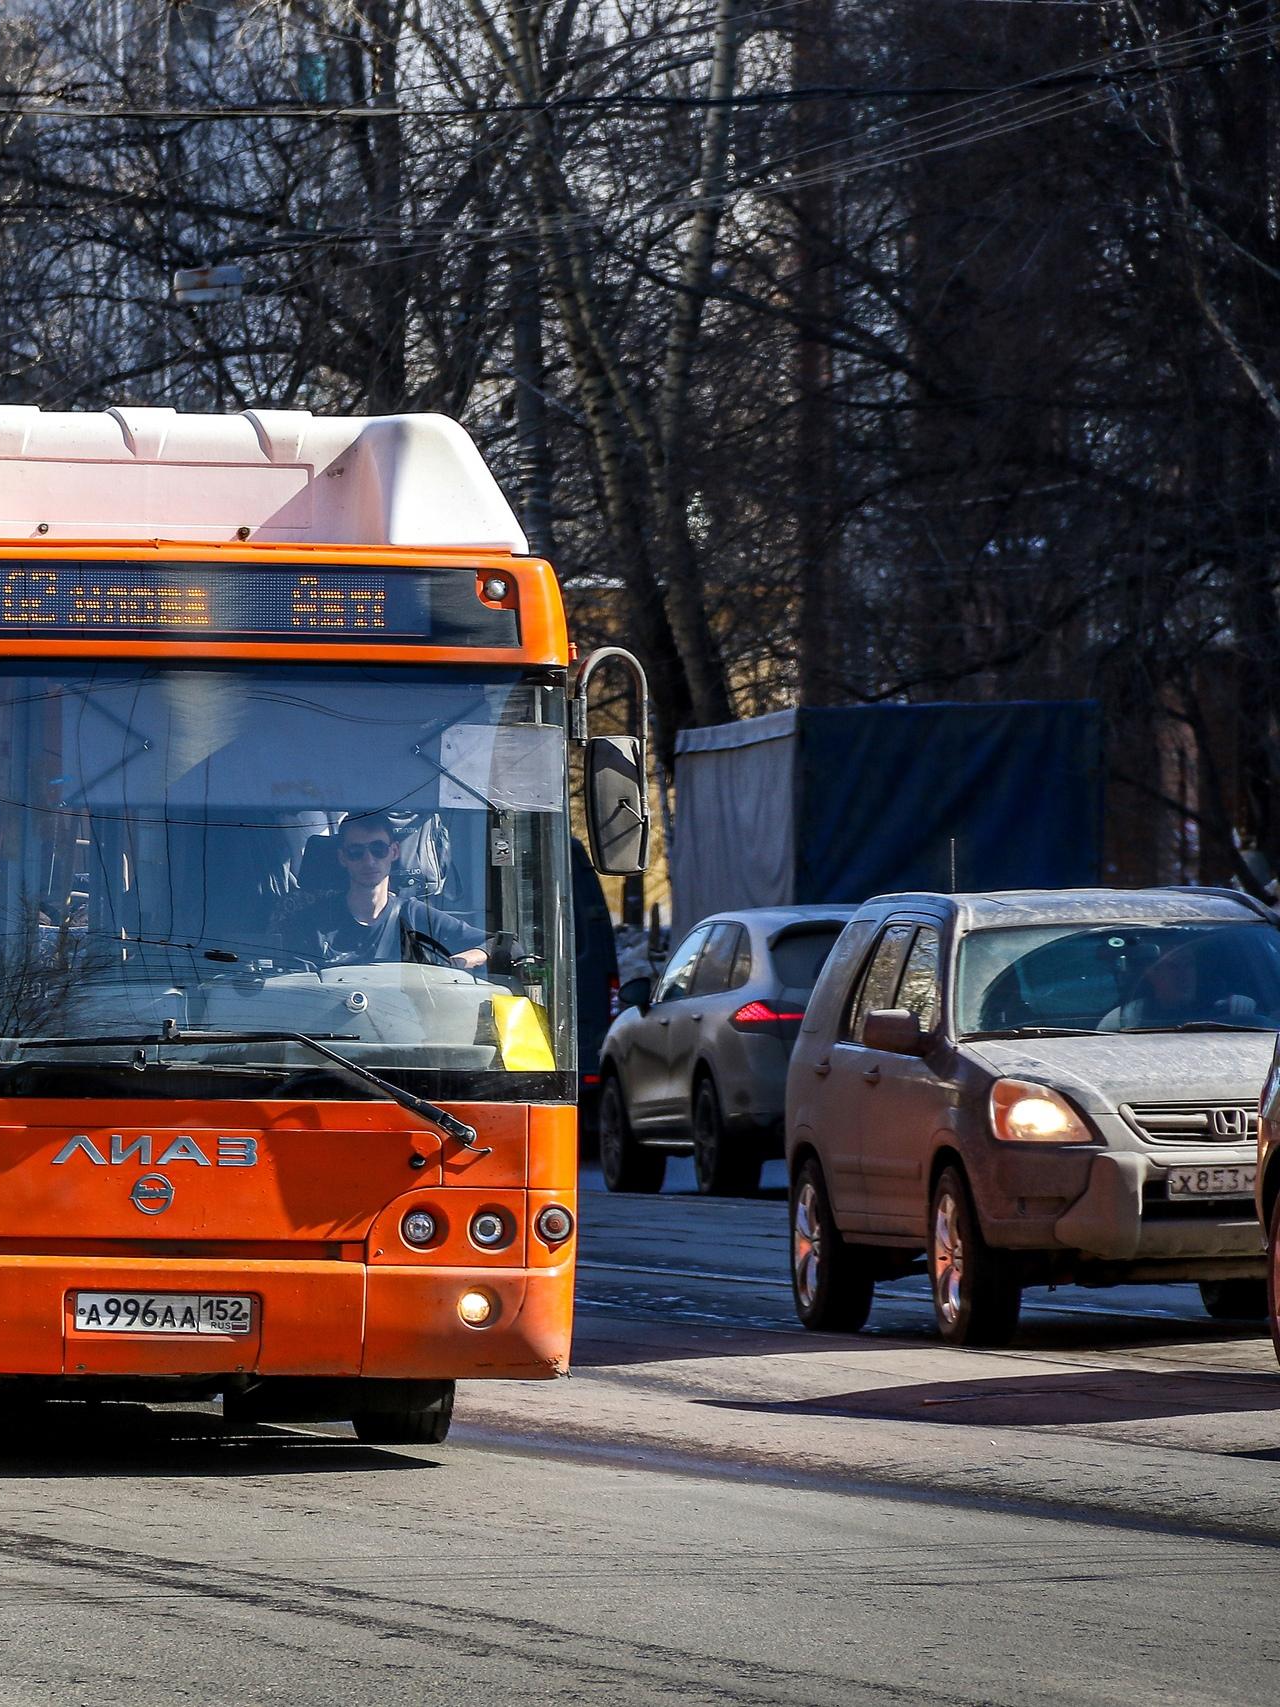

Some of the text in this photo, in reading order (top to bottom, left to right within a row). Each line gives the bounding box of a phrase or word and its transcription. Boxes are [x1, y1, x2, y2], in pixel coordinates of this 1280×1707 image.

[51, 1134, 258, 1167] ЛИАЗ
[202, 1299, 243, 1322] 152
[210, 1321, 231, 1330] RUS
